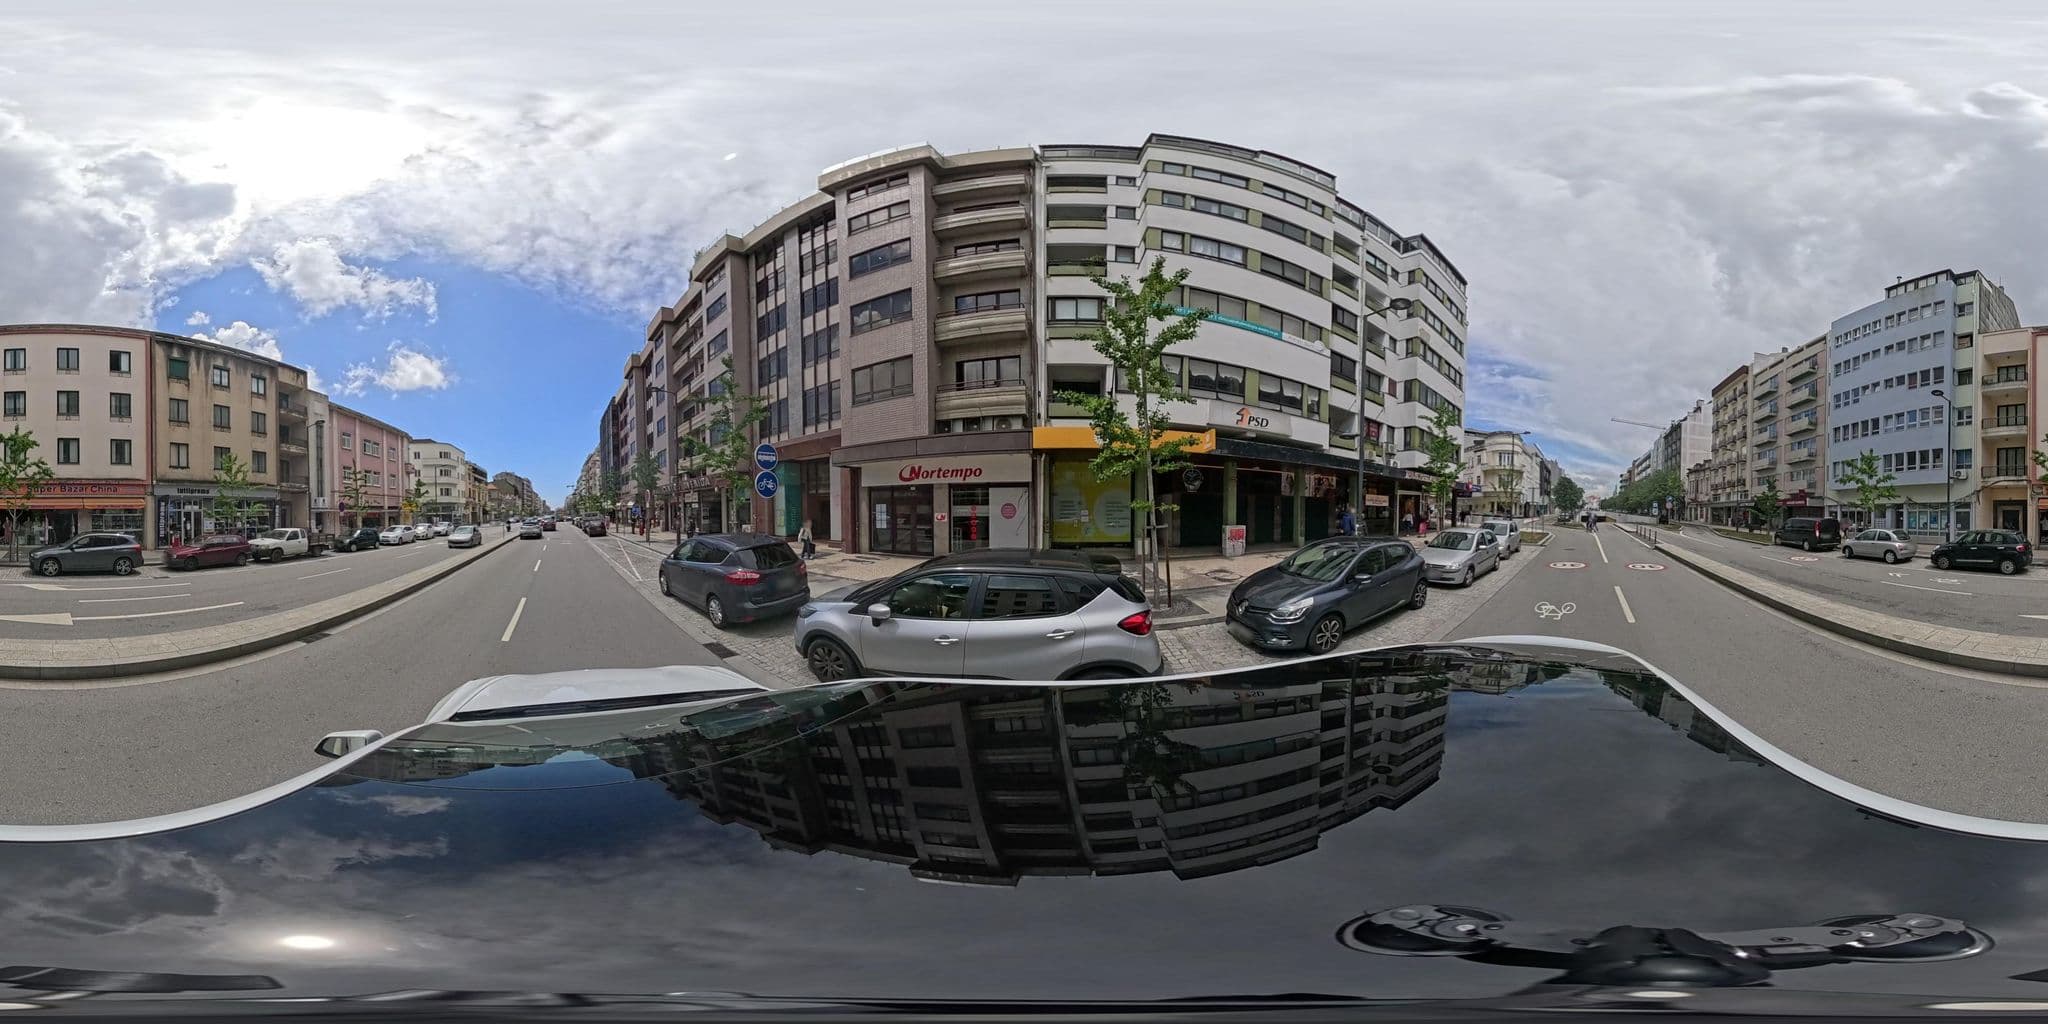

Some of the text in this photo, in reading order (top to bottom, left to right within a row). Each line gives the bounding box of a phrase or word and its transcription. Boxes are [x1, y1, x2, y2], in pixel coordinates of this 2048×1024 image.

[1248, 416, 1270, 428] PSD
[899, 464, 983, 481] Nortempo
[28, 484, 118, 493] Super Bazar China
